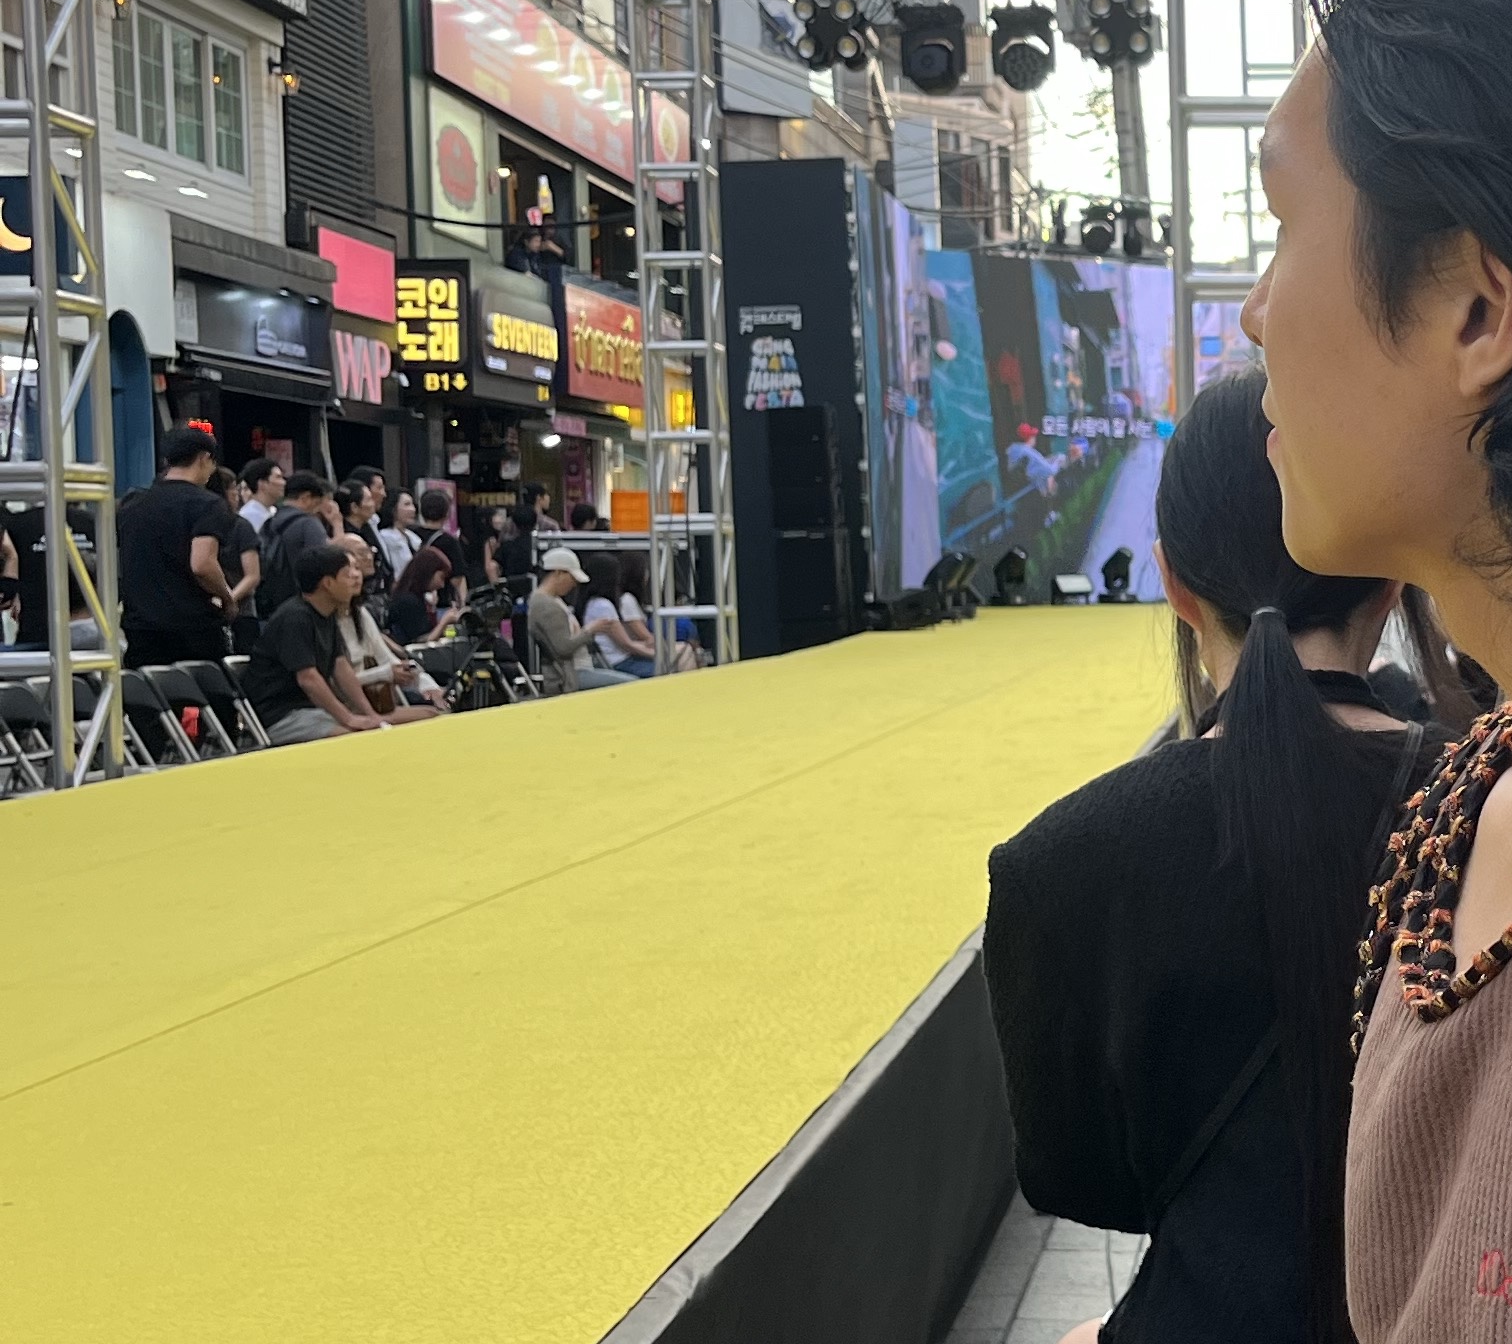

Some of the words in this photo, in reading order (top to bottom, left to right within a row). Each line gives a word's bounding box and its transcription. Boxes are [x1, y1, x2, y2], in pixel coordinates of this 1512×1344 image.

[396, 277, 460, 320] 코인
[397, 320, 461, 363] 노래
[490, 311, 560, 363] SEVENTEEN
[335, 330, 392, 405] WAP
